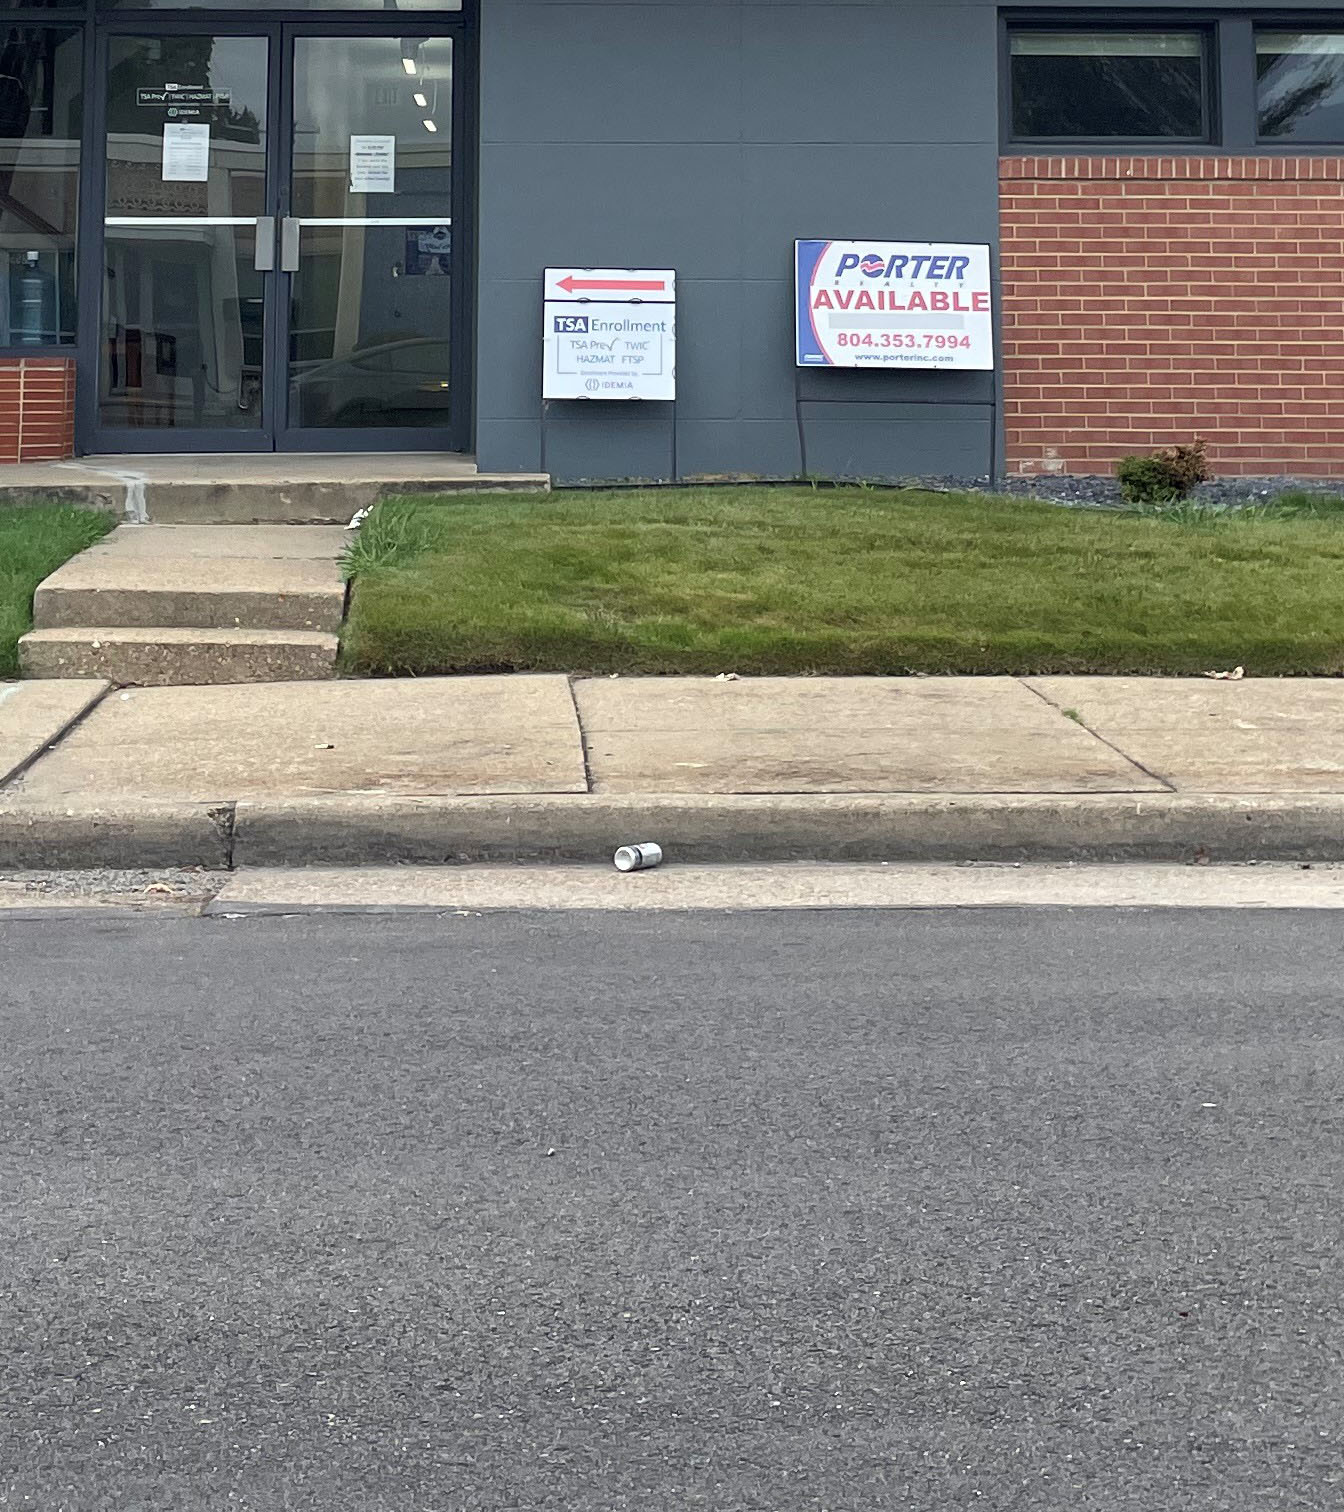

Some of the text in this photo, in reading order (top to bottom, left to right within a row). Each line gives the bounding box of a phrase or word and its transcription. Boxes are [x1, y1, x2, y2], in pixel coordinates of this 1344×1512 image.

[835, 254, 970, 280] PORTER
[813, 289, 990, 312] AVAILABLE
[555, 317, 667, 333] TSA Enrollment
[570, 340, 588, 350] TSA
[624, 341, 650, 350] TWIC
[836, 333, 971, 349] 804.353.7994
[576, 355, 644, 365] HAZMAT FTSP
[855, 353, 954, 363] www.porterinc.com
[602, 381, 634, 390] IDEMIA
